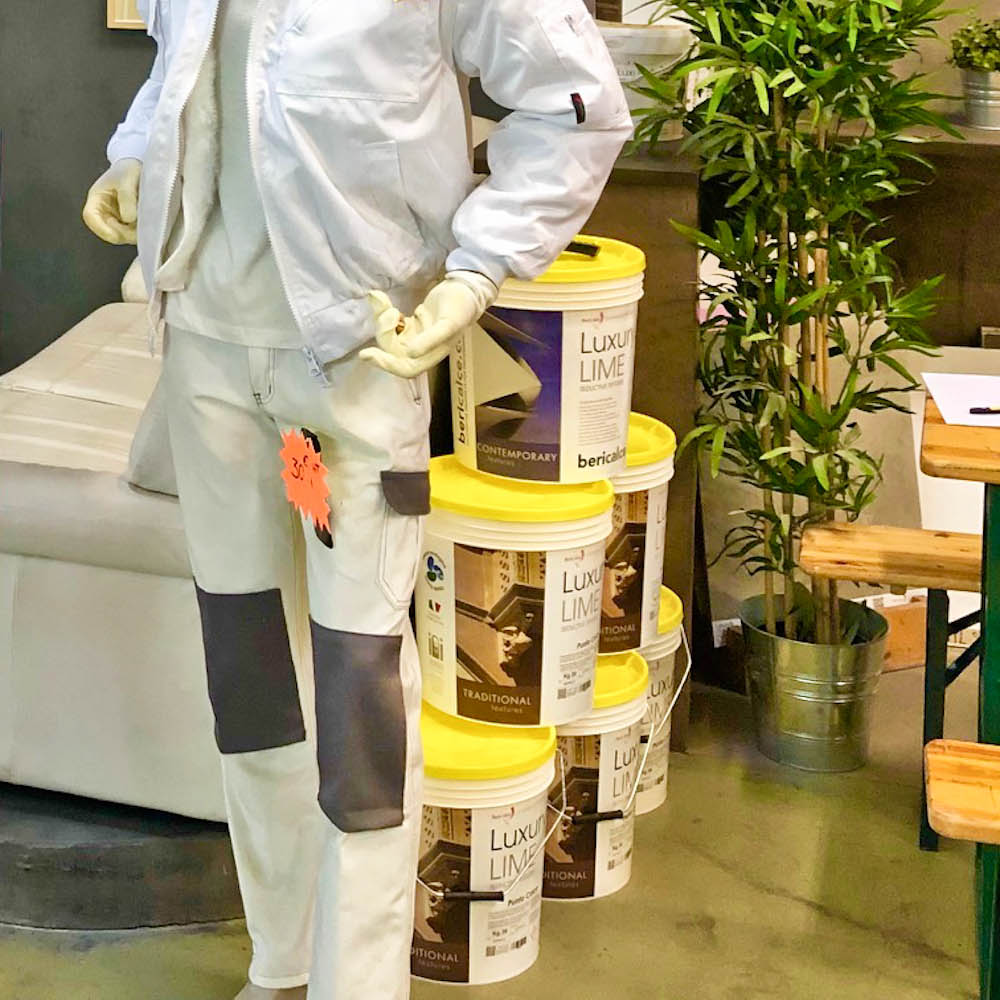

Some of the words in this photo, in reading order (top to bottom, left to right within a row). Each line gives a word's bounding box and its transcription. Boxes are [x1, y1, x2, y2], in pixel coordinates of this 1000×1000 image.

[580, 353, 626, 383] LIME
[477, 442, 558, 463] CONTEMPORARY
[561, 590, 601, 623] LIME
[463, 688, 532, 706] TRADITIONAL
